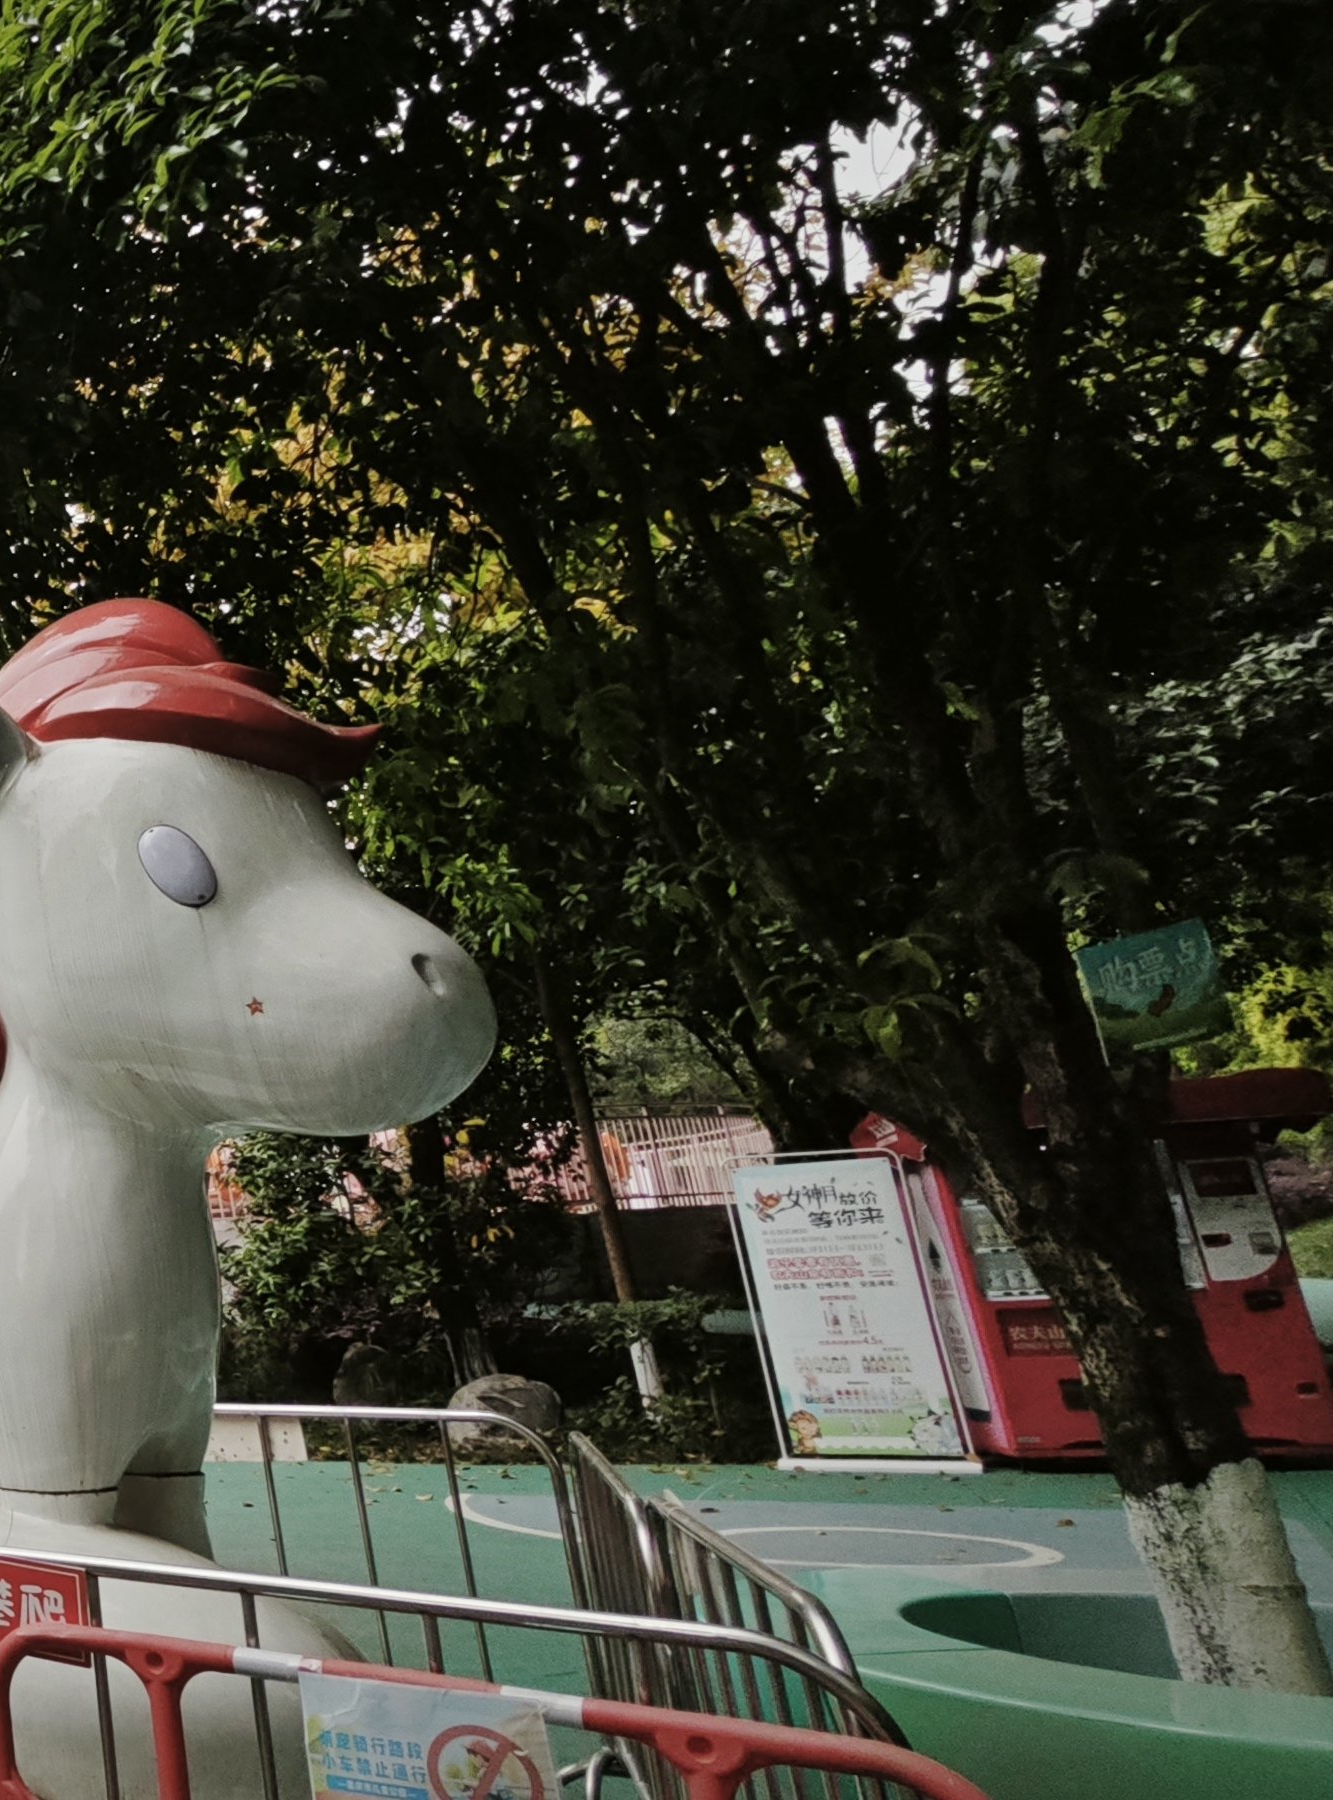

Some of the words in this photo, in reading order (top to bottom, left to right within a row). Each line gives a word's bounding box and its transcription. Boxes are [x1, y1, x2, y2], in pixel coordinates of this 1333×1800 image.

[1098, 938, 1210, 993] 购票点
[322, 1752, 427, 1784] 小车禁止通行
